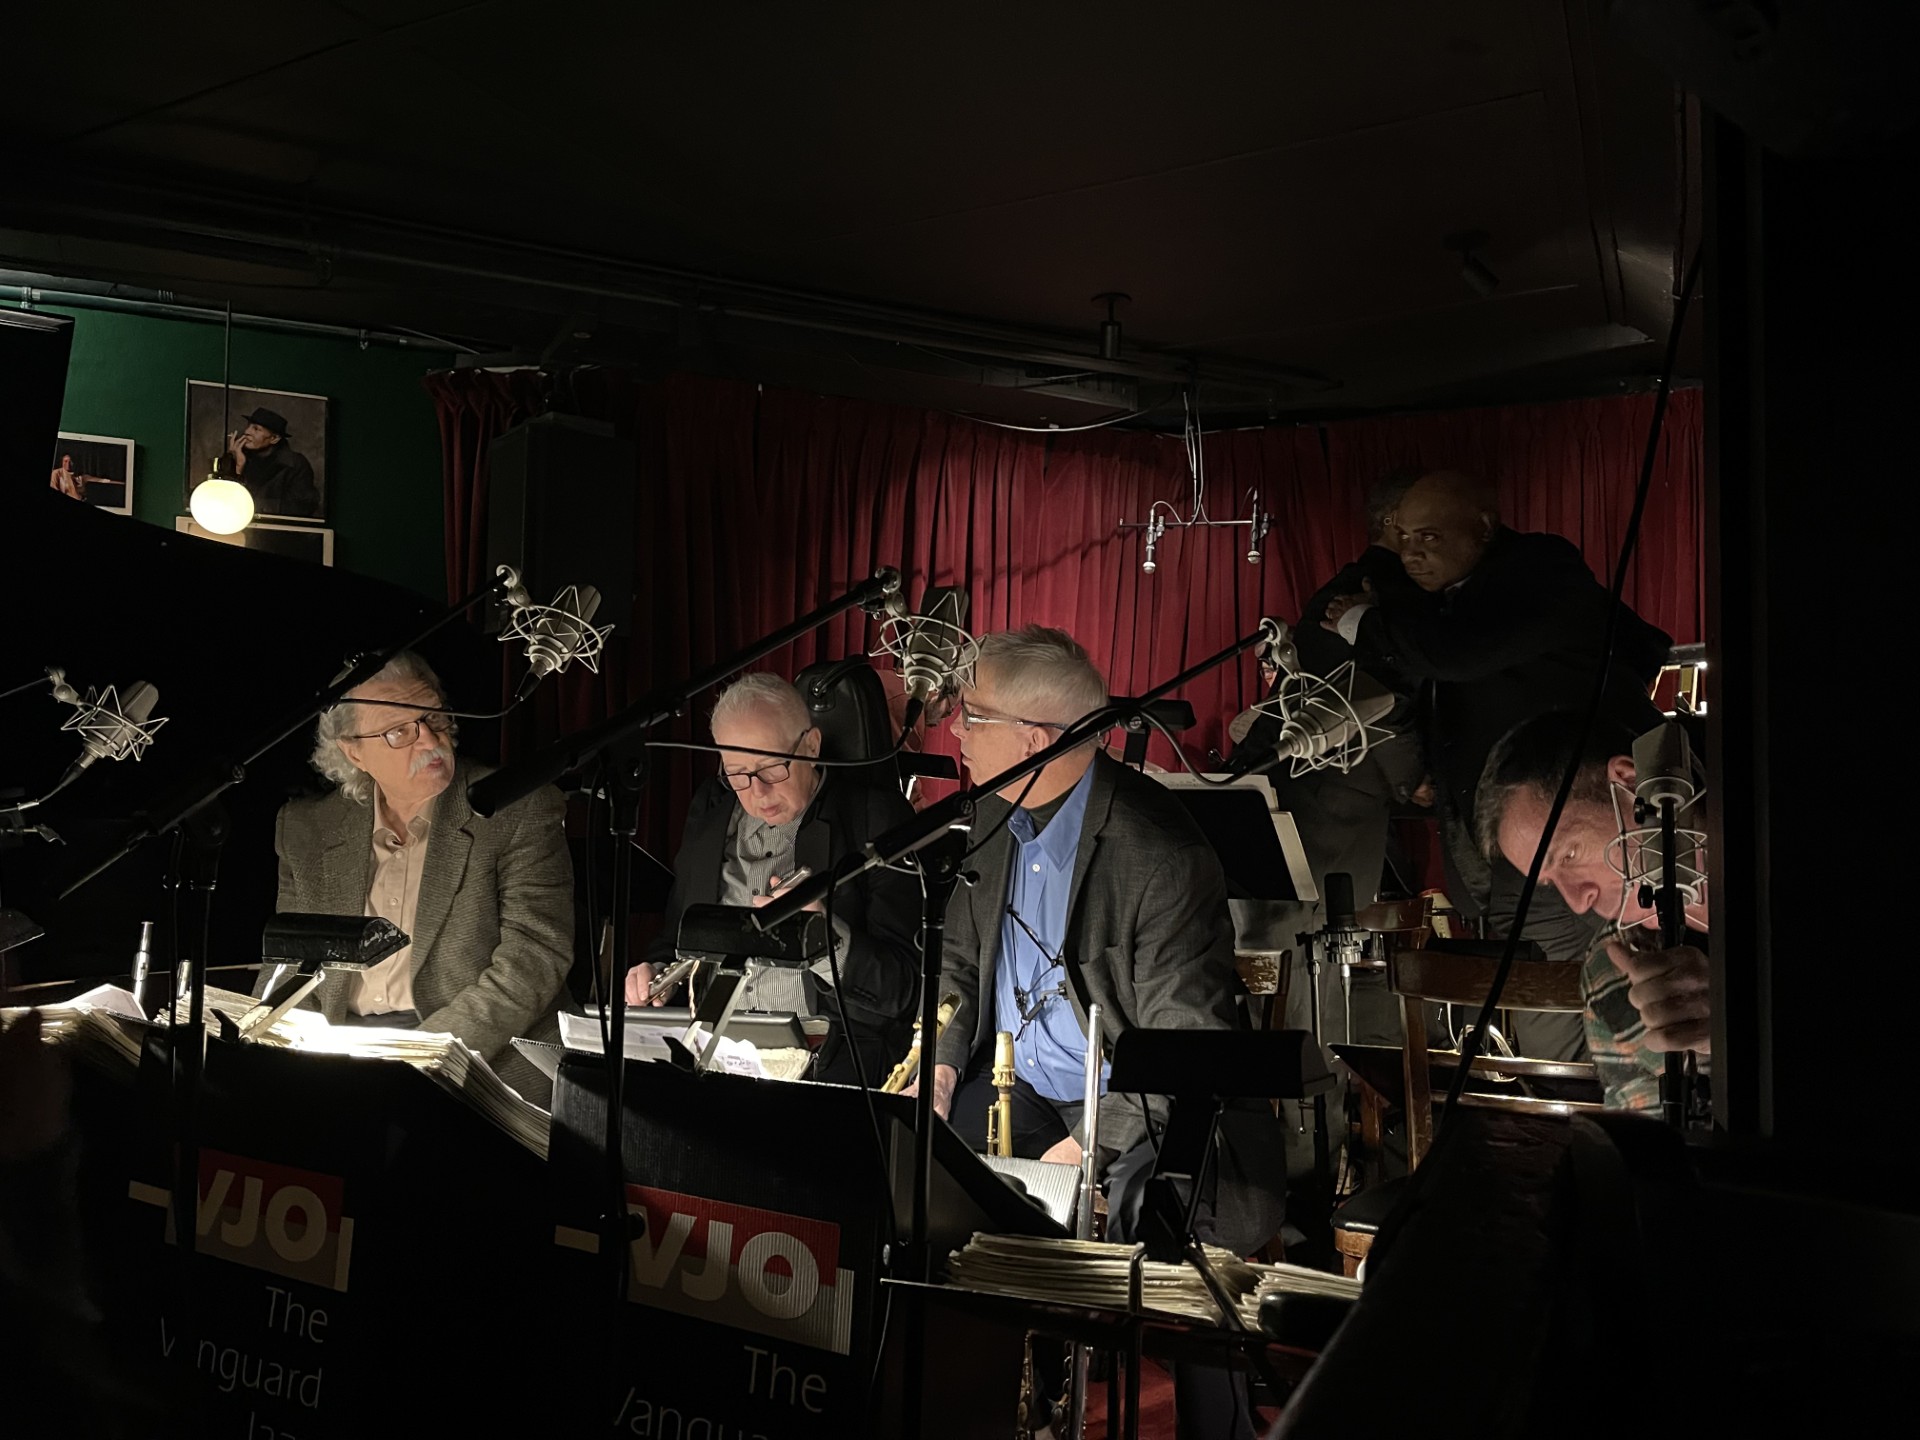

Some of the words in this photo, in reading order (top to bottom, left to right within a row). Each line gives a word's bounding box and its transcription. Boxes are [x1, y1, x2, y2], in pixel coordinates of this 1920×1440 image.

[626, 1202, 820, 1320] VJO
[265, 1285, 329, 1344] The
[160, 1315, 323, 1409] Vnguard
[743, 1344, 828, 1414] The
